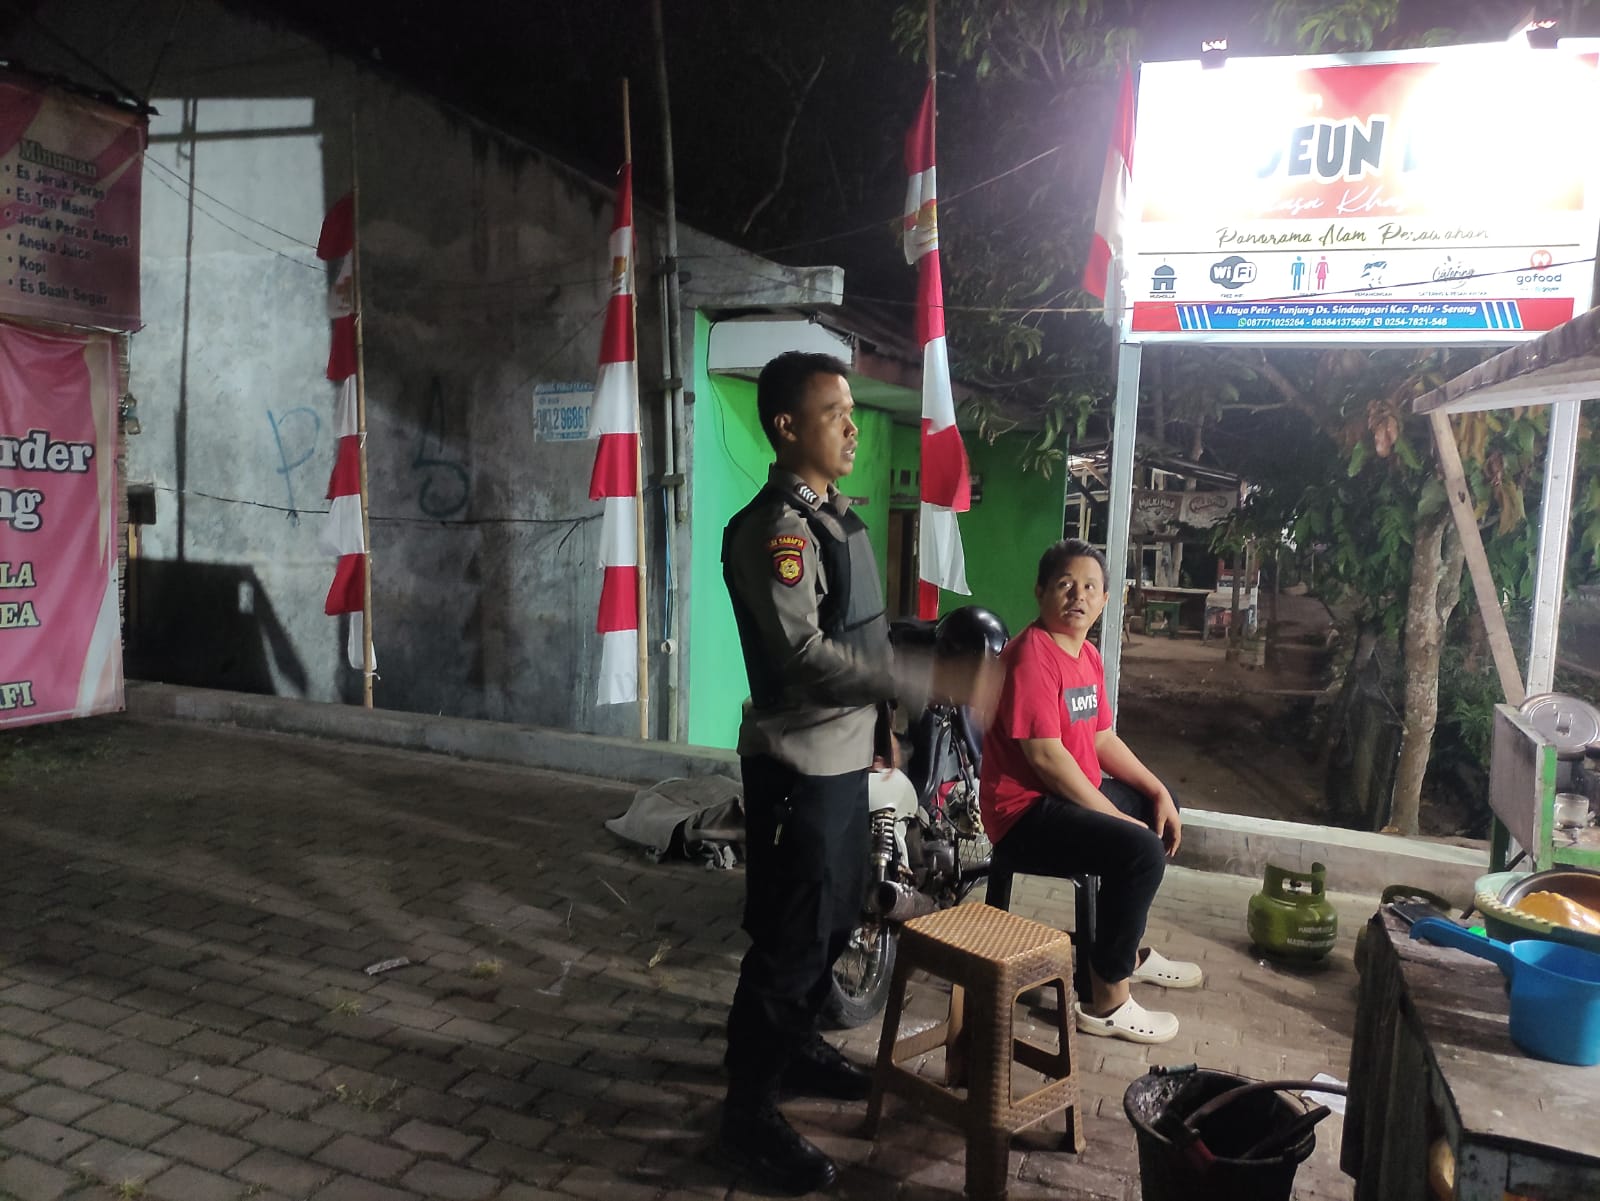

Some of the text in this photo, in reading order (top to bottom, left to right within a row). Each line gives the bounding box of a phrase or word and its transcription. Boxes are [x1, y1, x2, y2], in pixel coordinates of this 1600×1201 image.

[16, 164, 30, 181] Es
[35, 171, 68, 191] Jeruk
[16, 187, 95, 219] Es Teh Manis
[17, 212, 52, 231] Jeruk
[18, 233, 56, 253] Aneka
[1318, 223, 1366, 247] Alam
[18, 255, 47, 274] Kopi
[1516, 273, 1562, 285] gofood
[19, 278, 34, 294] Es
[39, 282, 70, 301] Buah
[1225, 306, 1249, 316] Raya
[1250, 305, 1272, 315] Petir
[1279, 304, 1314, 315] Tunjung
[1316, 305, 1330, 314] Ds.
[1332, 305, 1388, 315] Sindangsari
[1390, 304, 1410, 314] Kec.
[1411, 304, 1435, 313] Petir
[1441, 304, 1477, 315] Serang
